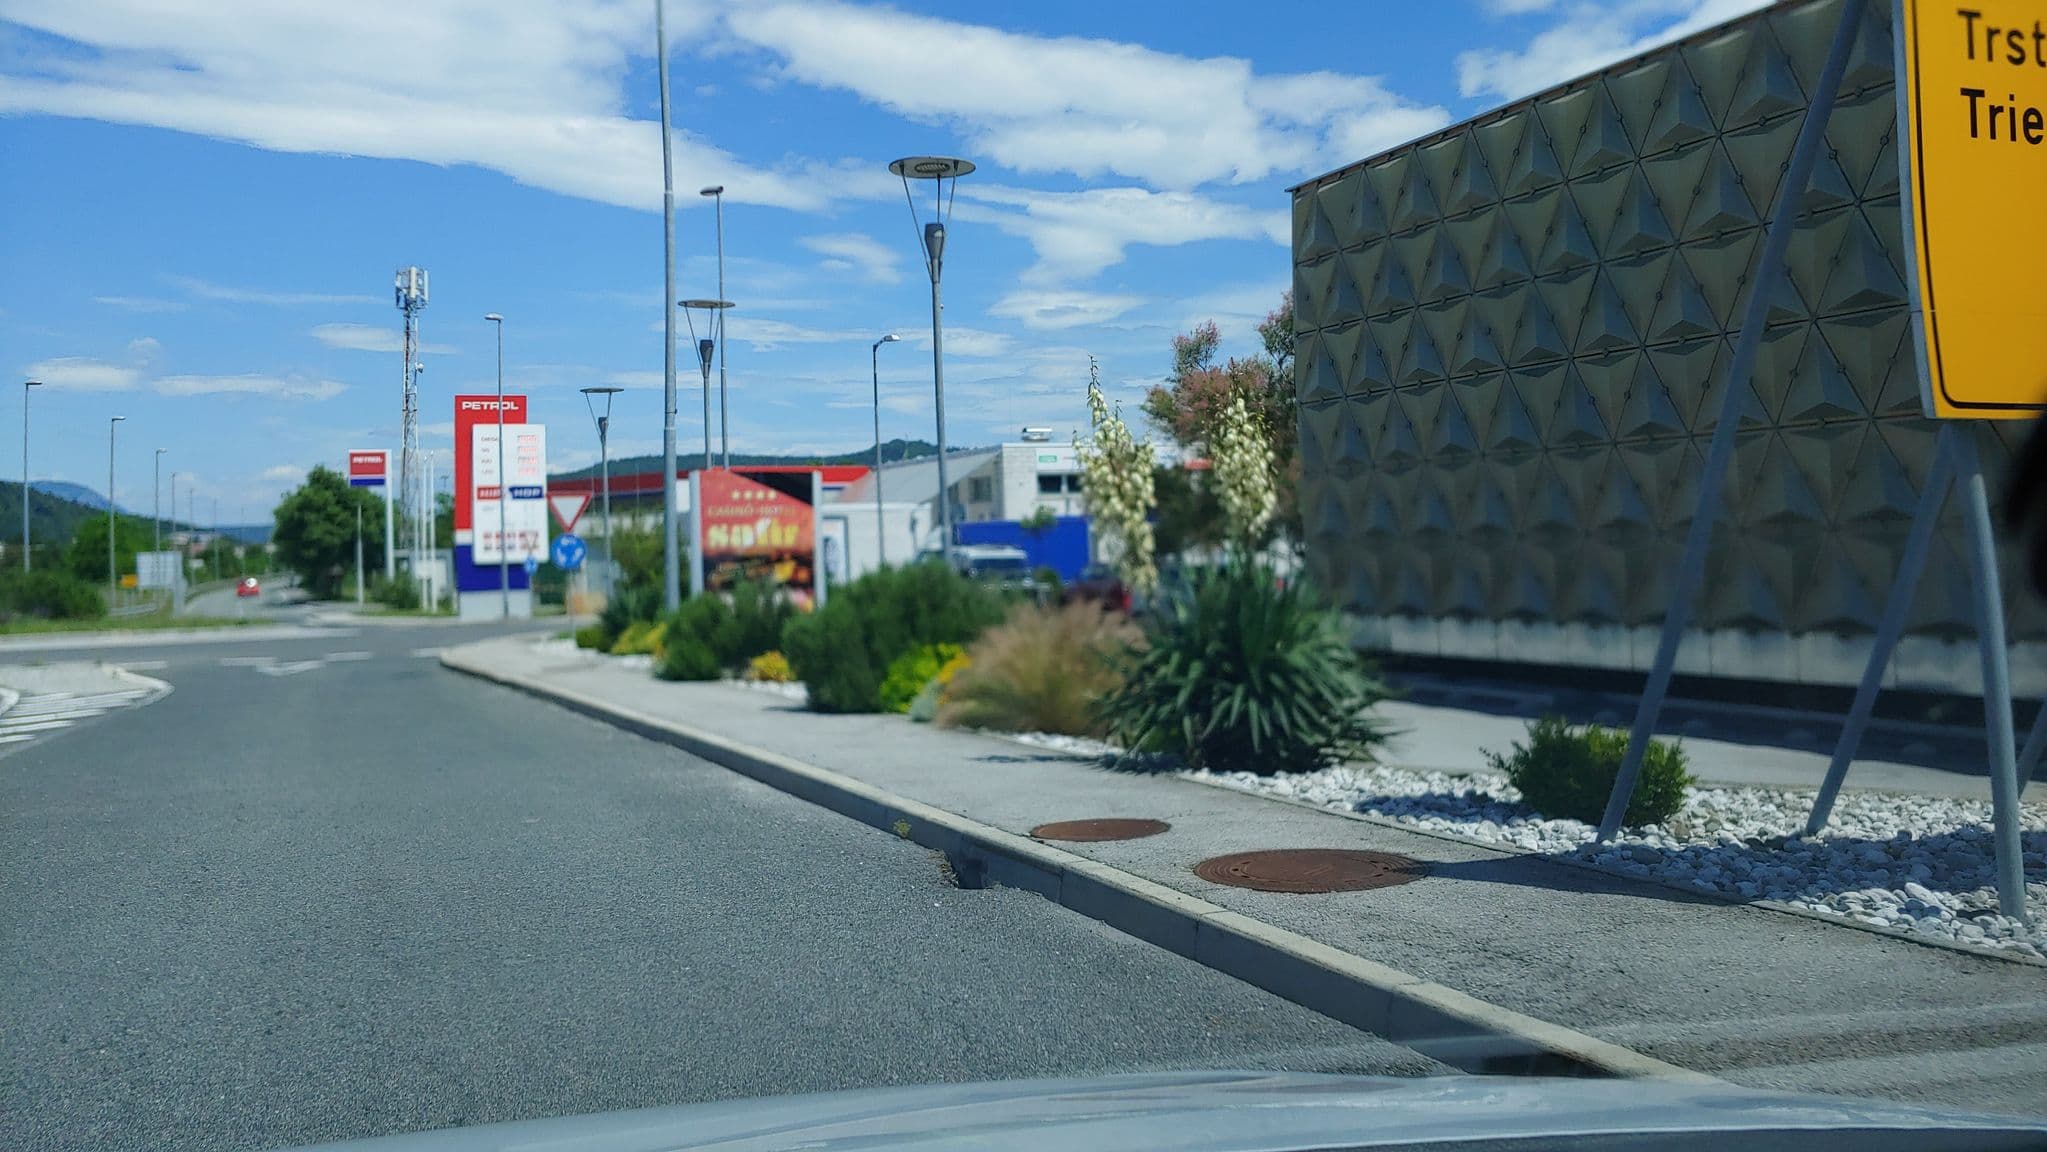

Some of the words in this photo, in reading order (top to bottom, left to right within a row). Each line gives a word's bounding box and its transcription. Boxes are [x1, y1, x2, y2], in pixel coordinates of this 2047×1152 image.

[1957, 9, 2047, 68] Trst
[1960, 87, 2045, 145] Trie
[461, 401, 519, 410] PETROL
